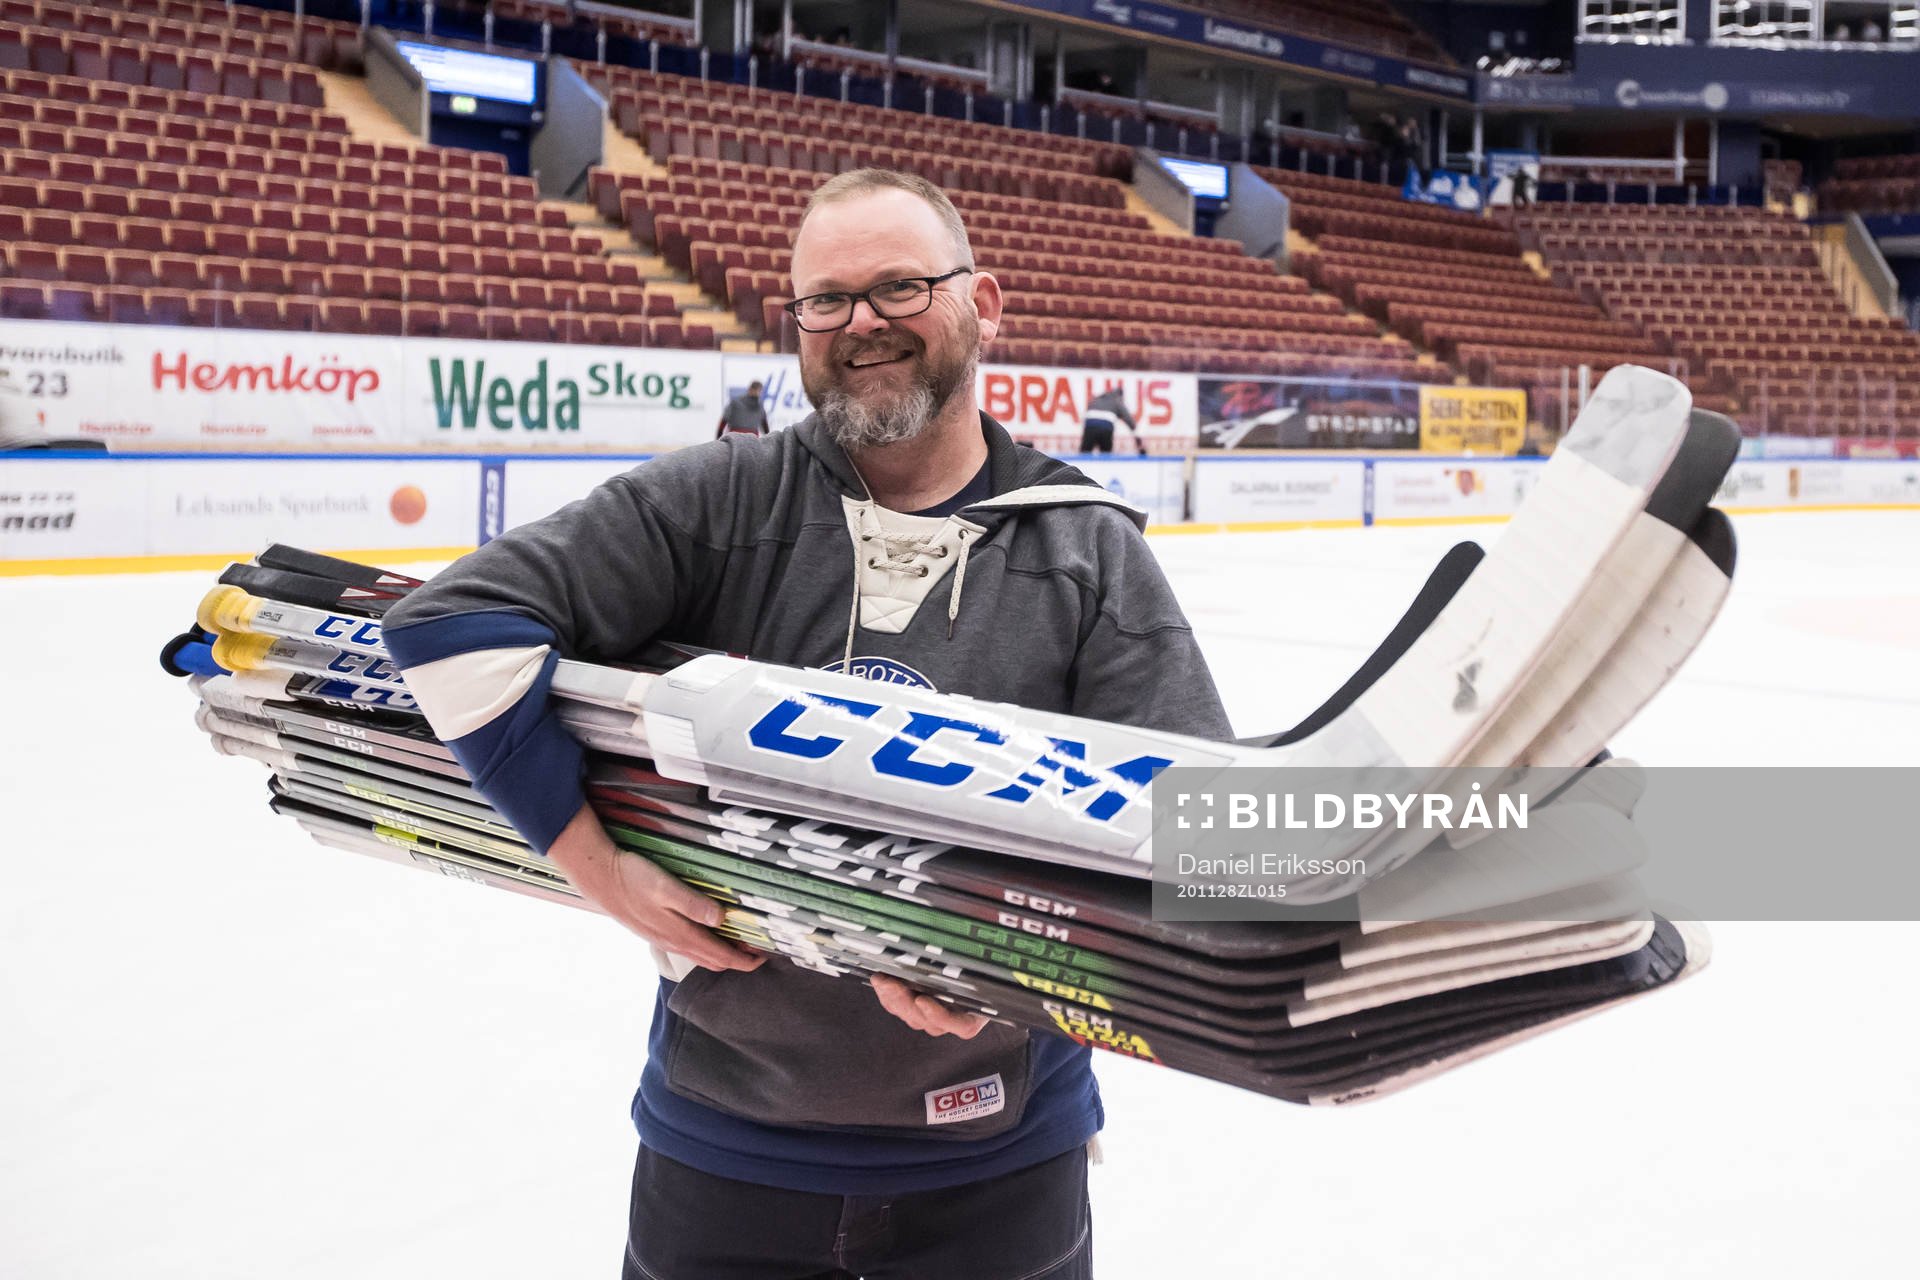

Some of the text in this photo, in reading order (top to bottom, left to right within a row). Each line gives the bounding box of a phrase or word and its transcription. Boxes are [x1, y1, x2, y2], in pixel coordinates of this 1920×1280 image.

[27, 370, 69, 397] 23
[152, 351, 380, 401] Hemköp
[429, 358, 692, 432] Weda Skog
[313, 614, 391, 650] CC
[327, 650, 407, 685] CC
[325, 721, 367, 740] CCM
[333, 736, 374, 755] CCM
[747, 690, 1178, 824] CCM
[1003, 888, 1078, 919] CCM
[998, 911, 1070, 942] CCM
[937, 1083, 998, 1110] CCM
